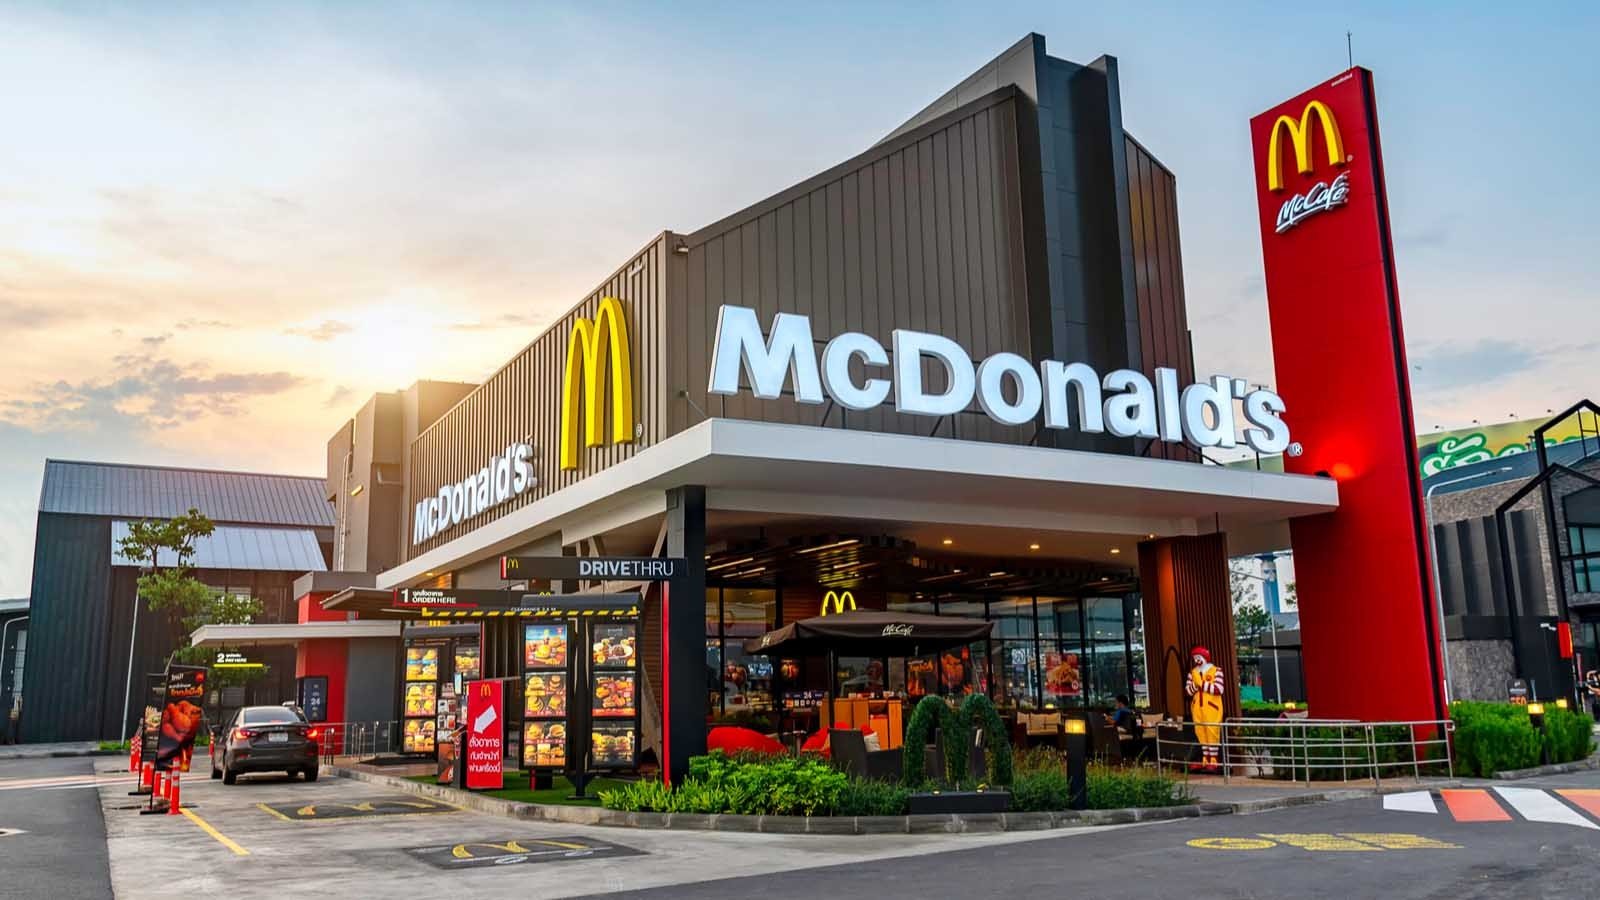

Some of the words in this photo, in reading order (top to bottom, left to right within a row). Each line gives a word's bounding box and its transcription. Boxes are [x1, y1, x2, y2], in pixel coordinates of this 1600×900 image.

[708, 304, 1291, 455] McDonald's
[413, 442, 535, 545] McDonald's
[401, 588, 409, 603] 1
[216, 653, 225, 663] 2
